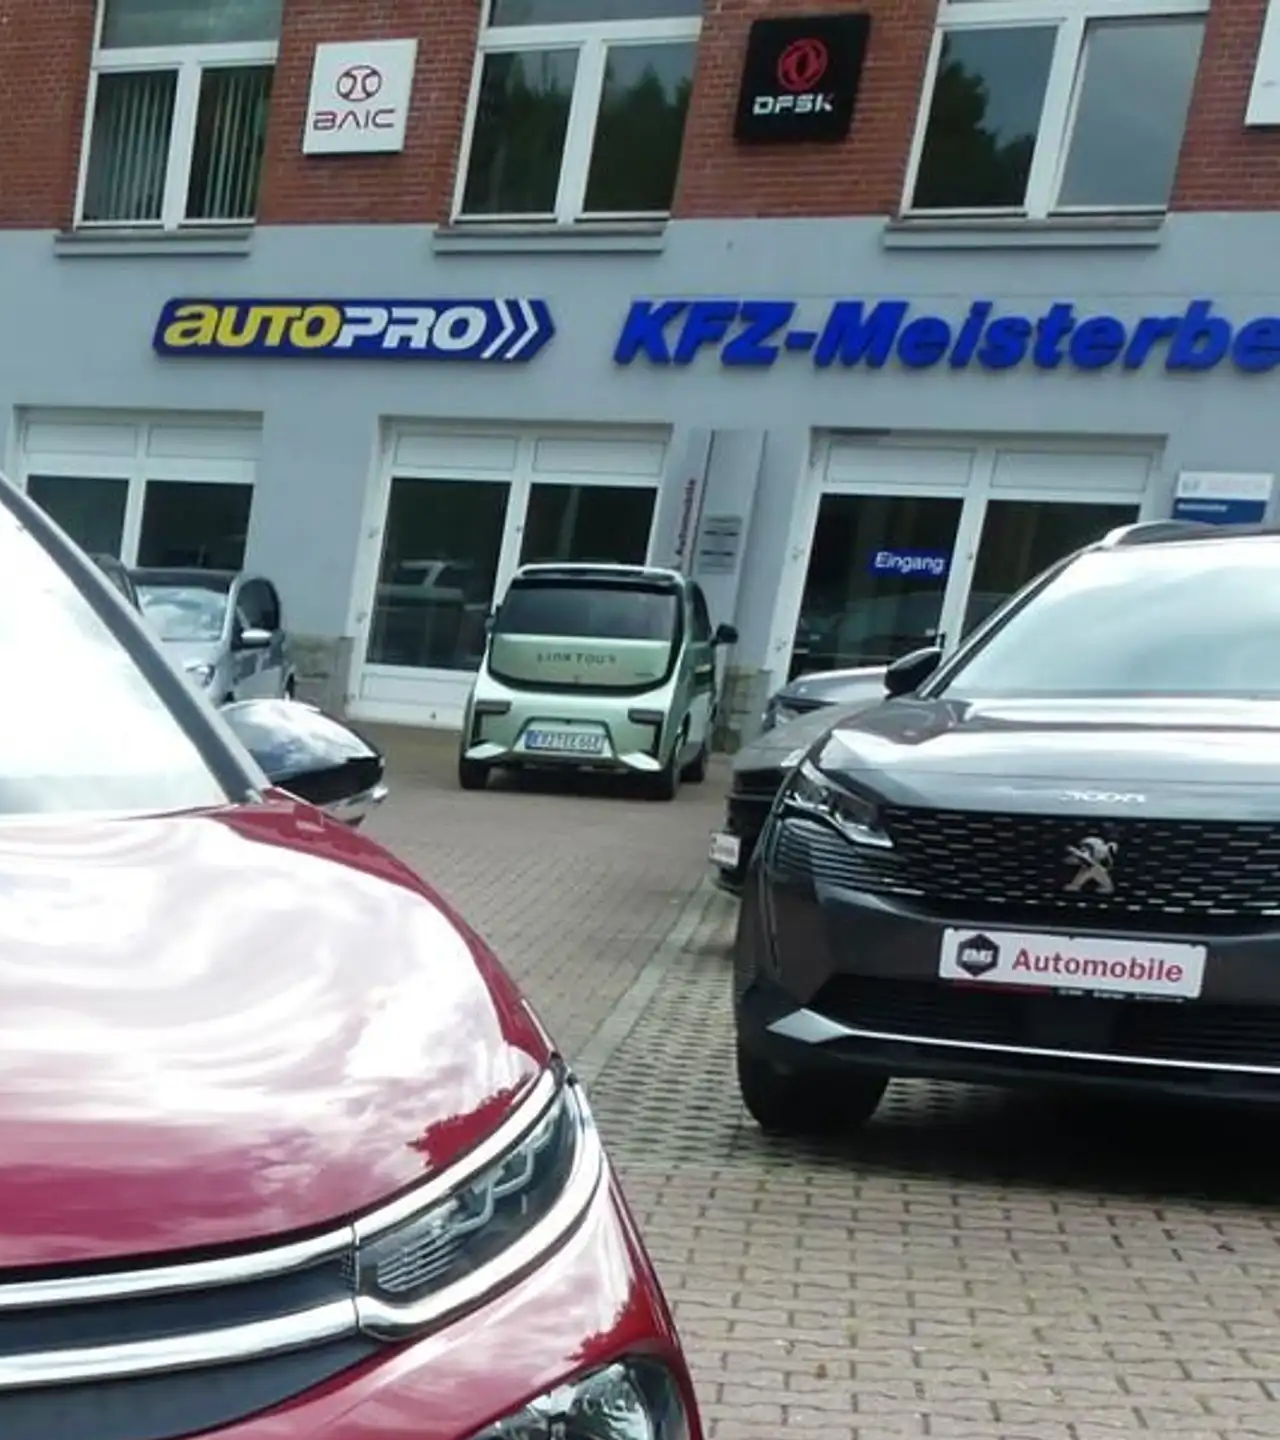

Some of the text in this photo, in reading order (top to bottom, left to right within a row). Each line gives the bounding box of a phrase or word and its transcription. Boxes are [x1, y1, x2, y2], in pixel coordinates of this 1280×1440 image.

[752, 93, 834, 115] DFSK
[313, 109, 396, 131] BAIC
[875, 551, 946, 575] Eingang
[1011, 948, 1184, 983] Automobile
